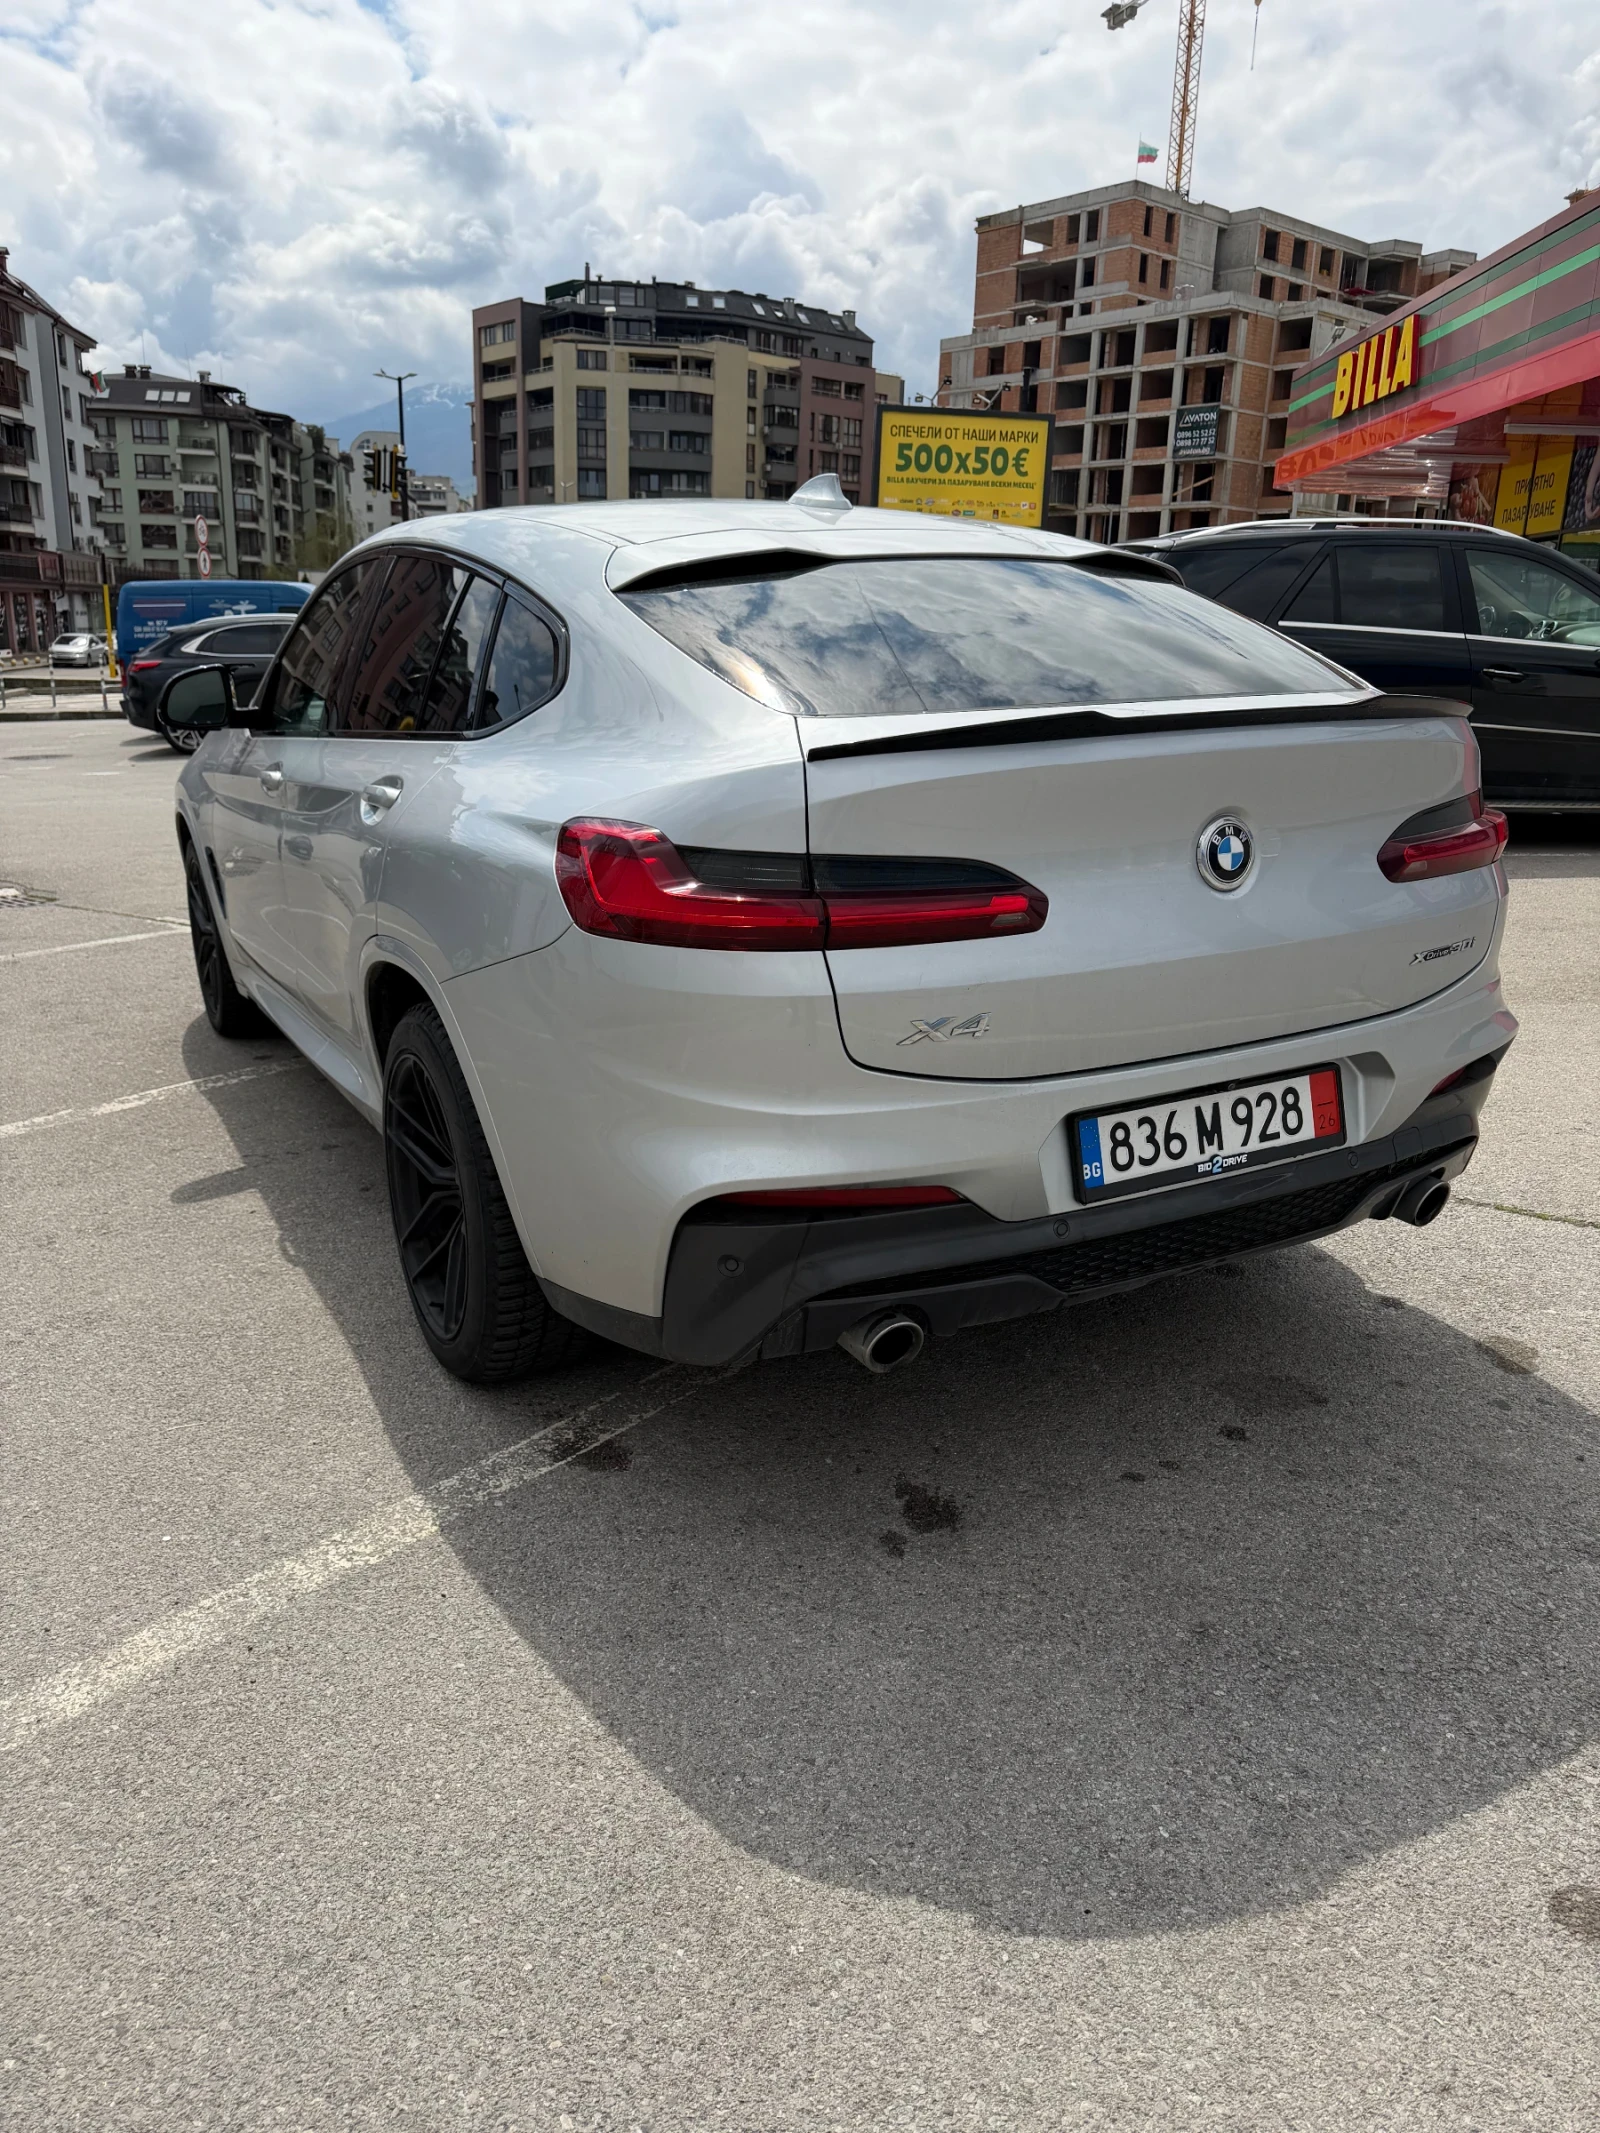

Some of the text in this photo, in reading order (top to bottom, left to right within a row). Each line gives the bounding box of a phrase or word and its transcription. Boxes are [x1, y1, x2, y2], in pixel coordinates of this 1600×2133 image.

[1332, 314, 1419, 419] BILLA
[1183, 412, 1217, 424] AVATON
[890, 424, 1039, 444] СПЕЧЕЛИ ОТ НАШИ МАРКИ
[887, 476, 905, 484] BILLA
[906, 477, 937, 485] ВАУЧЕРИ
[938, 478, 947, 486] ЗА
[947, 479, 990, 488] ПАЗАРУВАНЕ
[991, 480, 1012, 489] ВСЕКИ
[1514, 472, 1556, 496] ПРИЯТНО
[1502, 499, 1557, 524] ПАЗАРУВАНЕ
[1212, 826, 1249, 846] BMW
[896, 1012, 992, 1046] X4
[1109, 1086, 1304, 1172] 836 M 928
[1318, 1112, 1336, 1130] 26
[1083, 1162, 1101, 1180] BG
